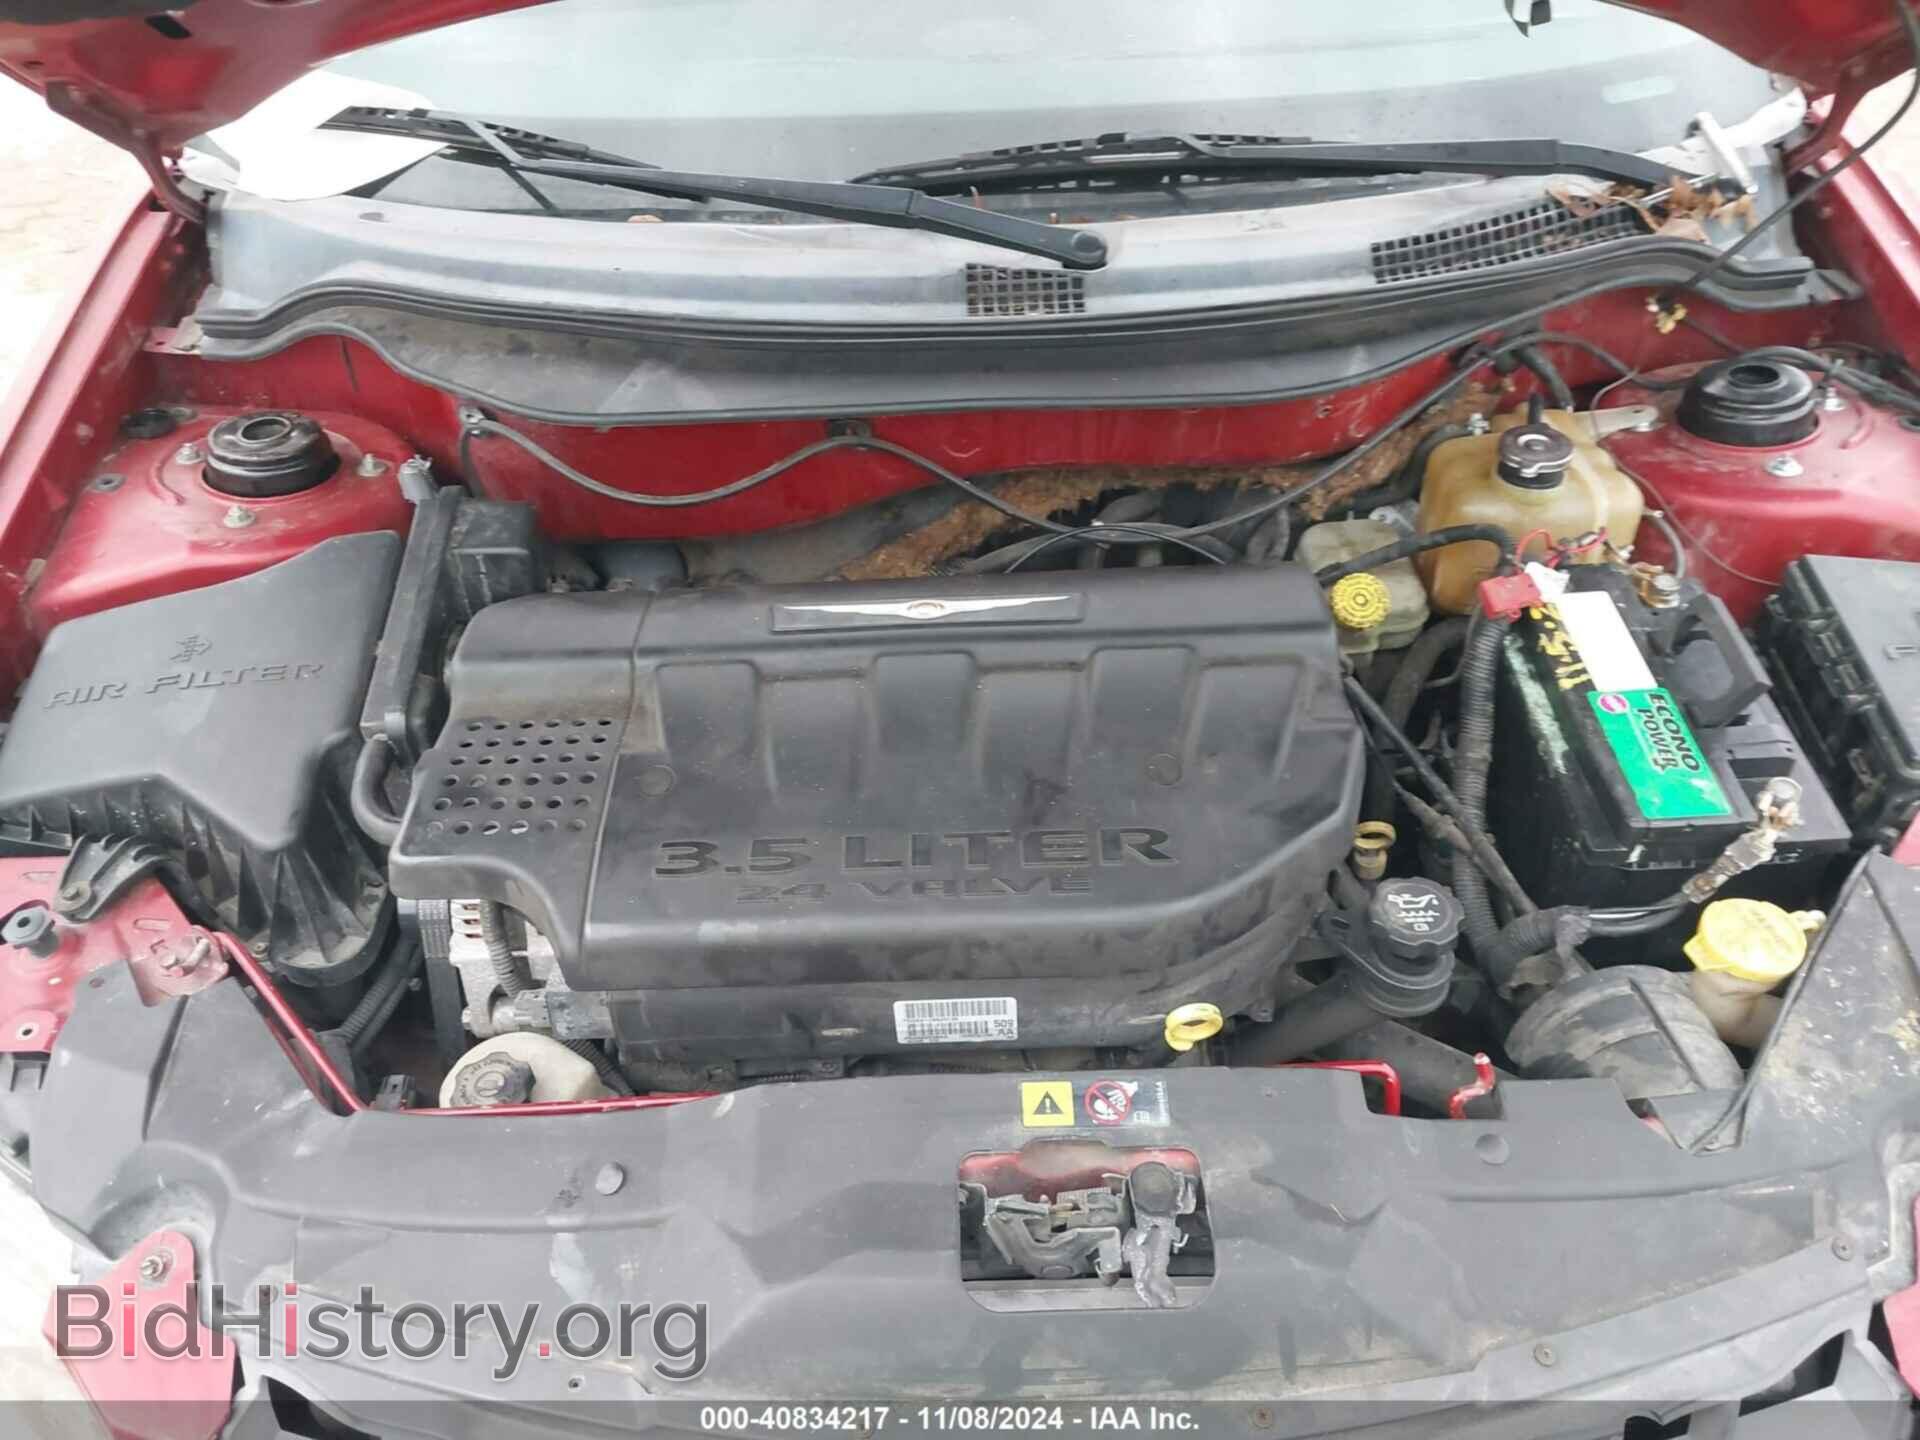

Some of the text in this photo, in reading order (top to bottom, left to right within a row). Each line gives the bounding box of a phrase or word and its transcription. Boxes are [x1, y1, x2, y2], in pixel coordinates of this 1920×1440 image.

[43, 664, 325, 710] AIR FILTER
[1637, 708, 1679, 768] POWER
[1649, 692, 1700, 771] ECONO
[654, 828, 1179, 878] 3.5 LITER
[737, 876, 1094, 903] 24 VALVE
